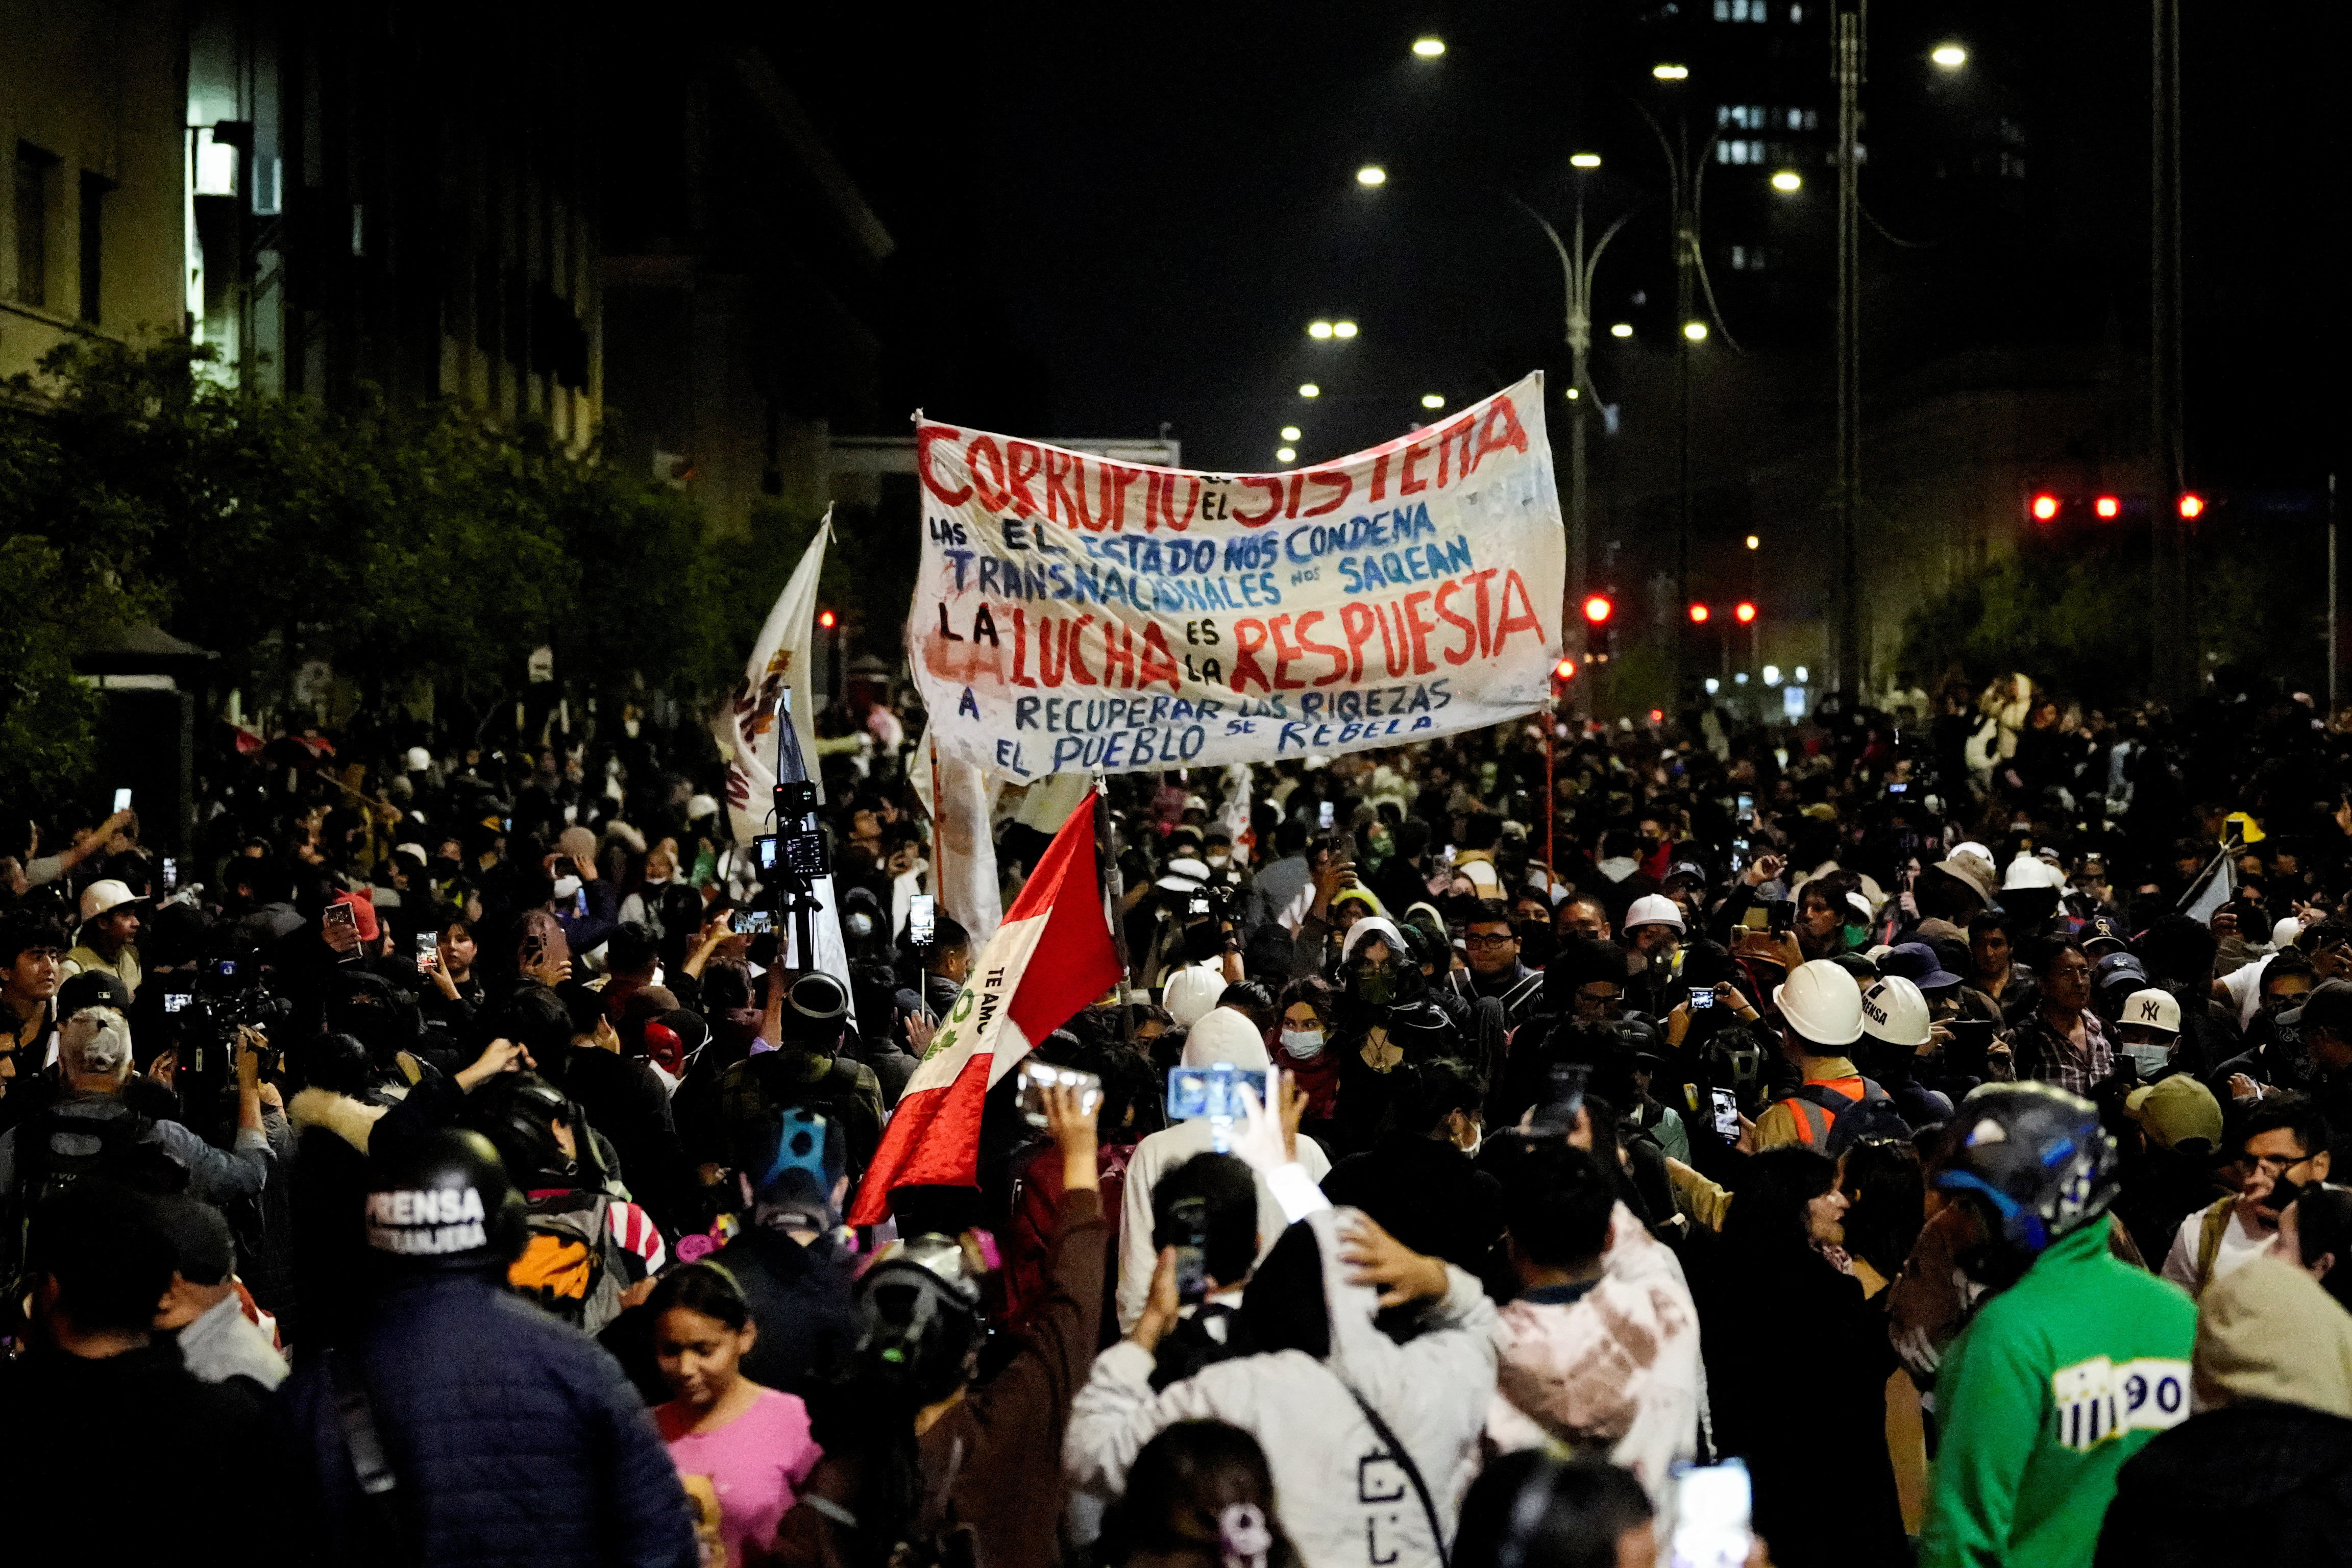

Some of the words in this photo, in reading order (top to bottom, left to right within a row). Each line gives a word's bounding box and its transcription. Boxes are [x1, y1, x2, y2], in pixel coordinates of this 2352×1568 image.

[1203, 492, 1228, 521] EL
[929, 517, 967, 545] LAS
[1002, 518, 1069, 555] EL
[1079, 535, 1216, 576] ESTADO
[1224, 531, 1278, 571] NOS
[1286, 501, 1436, 564] CONDENA
[1291, 567, 1320, 585] NOS
[1338, 535, 1474, 594] SAQEAN
[939, 602, 999, 647] LA
[1187, 619, 1220, 645] ES
[1230, 568, 1545, 693] RESPUESTA
[1011, 608, 1181, 693] LUCHA
[1185, 654, 1222, 685] LA
[959, 687, 980, 721] A
[1016, 695, 1224, 732] RECUPERAR
[1301, 678, 1452, 723] RIQEZAS
[997, 739, 1031, 776] EL
[1053, 725, 1205, 772] PUEBLO
[1225, 720, 1257, 736] SE
[986, 967, 1005, 988] TE
[2140, 1000, 2160, 1021] NY
[2125, 1374, 2181, 1413] 90
